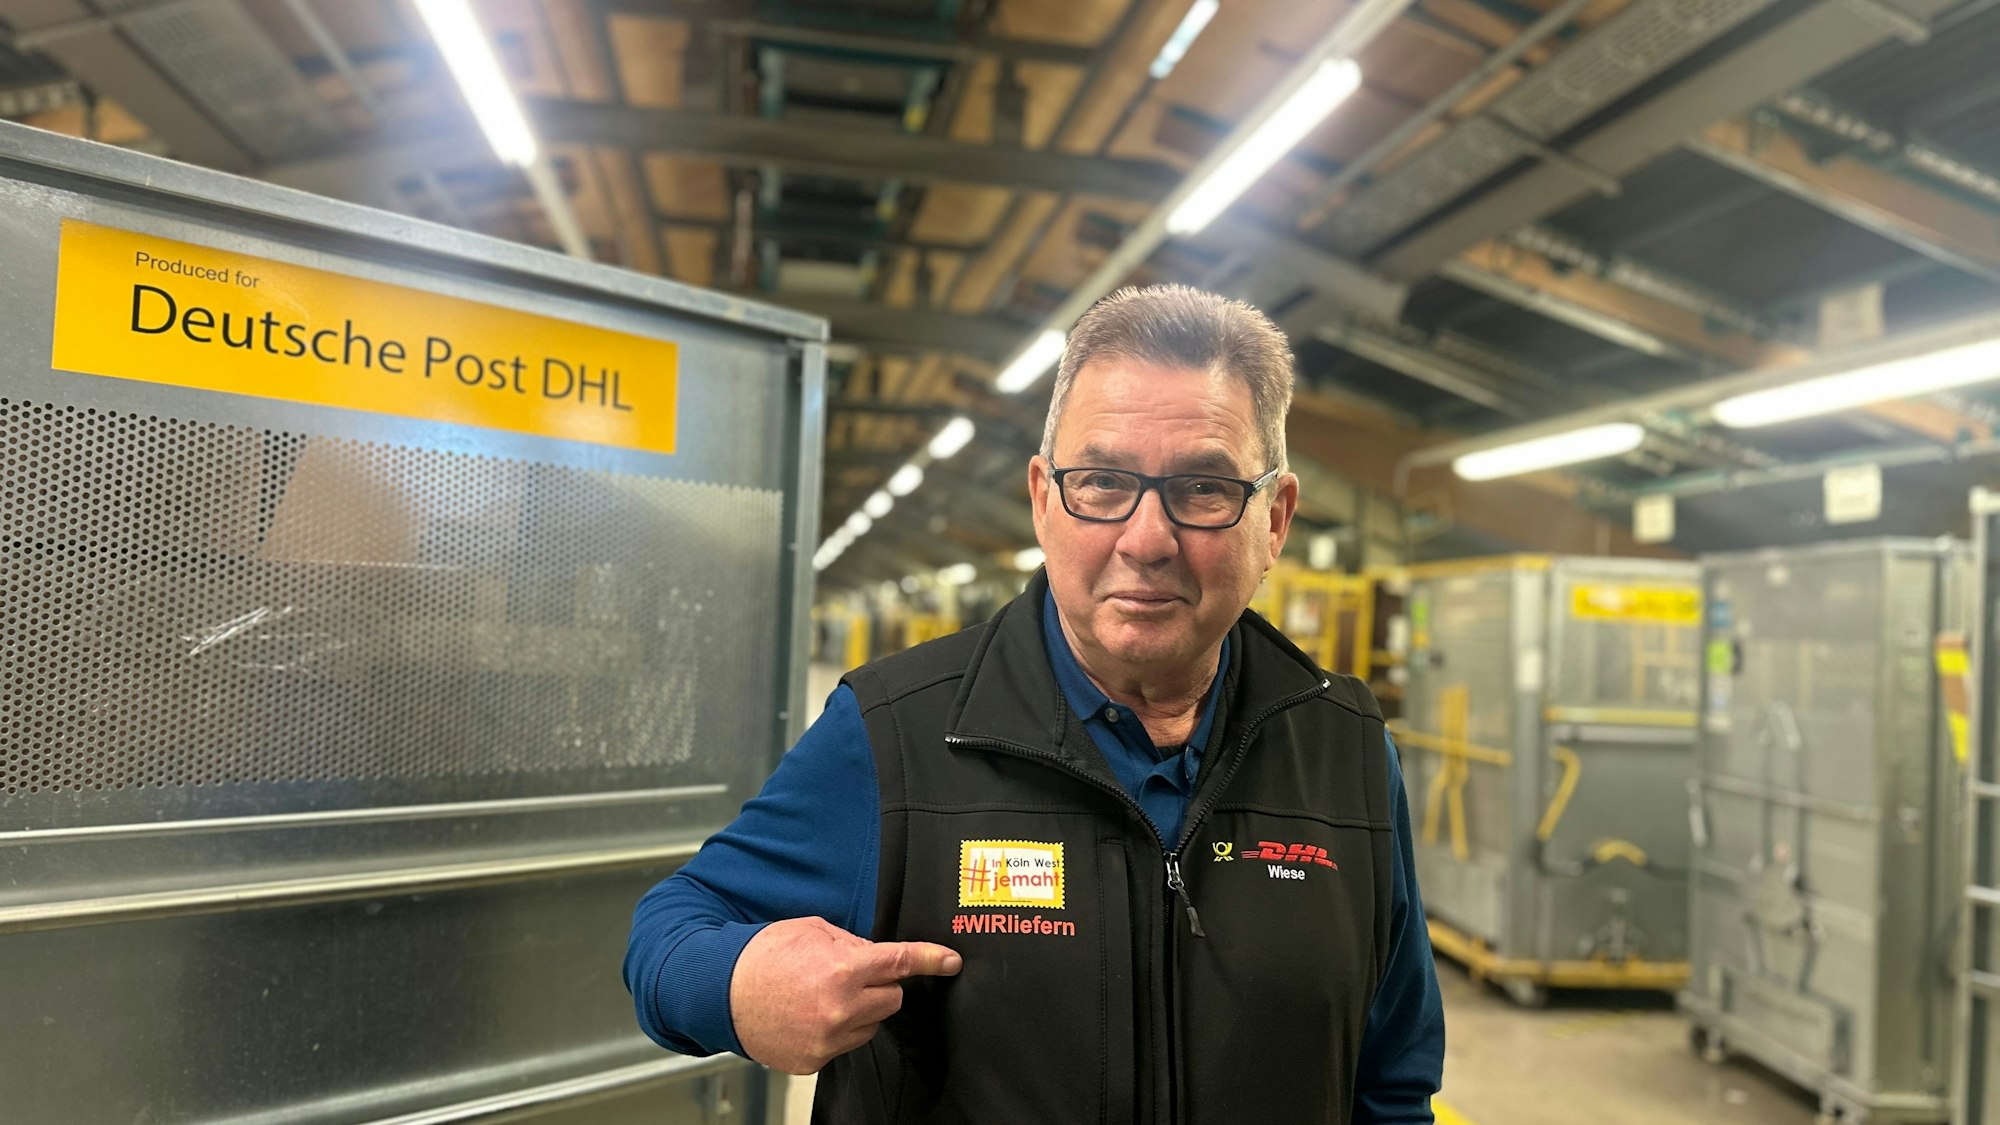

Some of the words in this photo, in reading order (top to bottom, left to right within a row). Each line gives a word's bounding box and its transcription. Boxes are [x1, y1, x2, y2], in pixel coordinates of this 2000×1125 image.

[135, 251, 229, 283] Produced
[235, 268, 260, 289] for
[130, 284, 406, 374] Deutsche
[424, 337, 527, 394] Post
[543, 358, 634, 411] DHL
[1006, 857, 1030, 868] Köln
[1034, 858, 1060, 868] West
[1257, 841, 1338, 870] DHL
[1267, 864, 1306, 880] Wiese
[952, 914, 1076, 936] #WIRliefern
